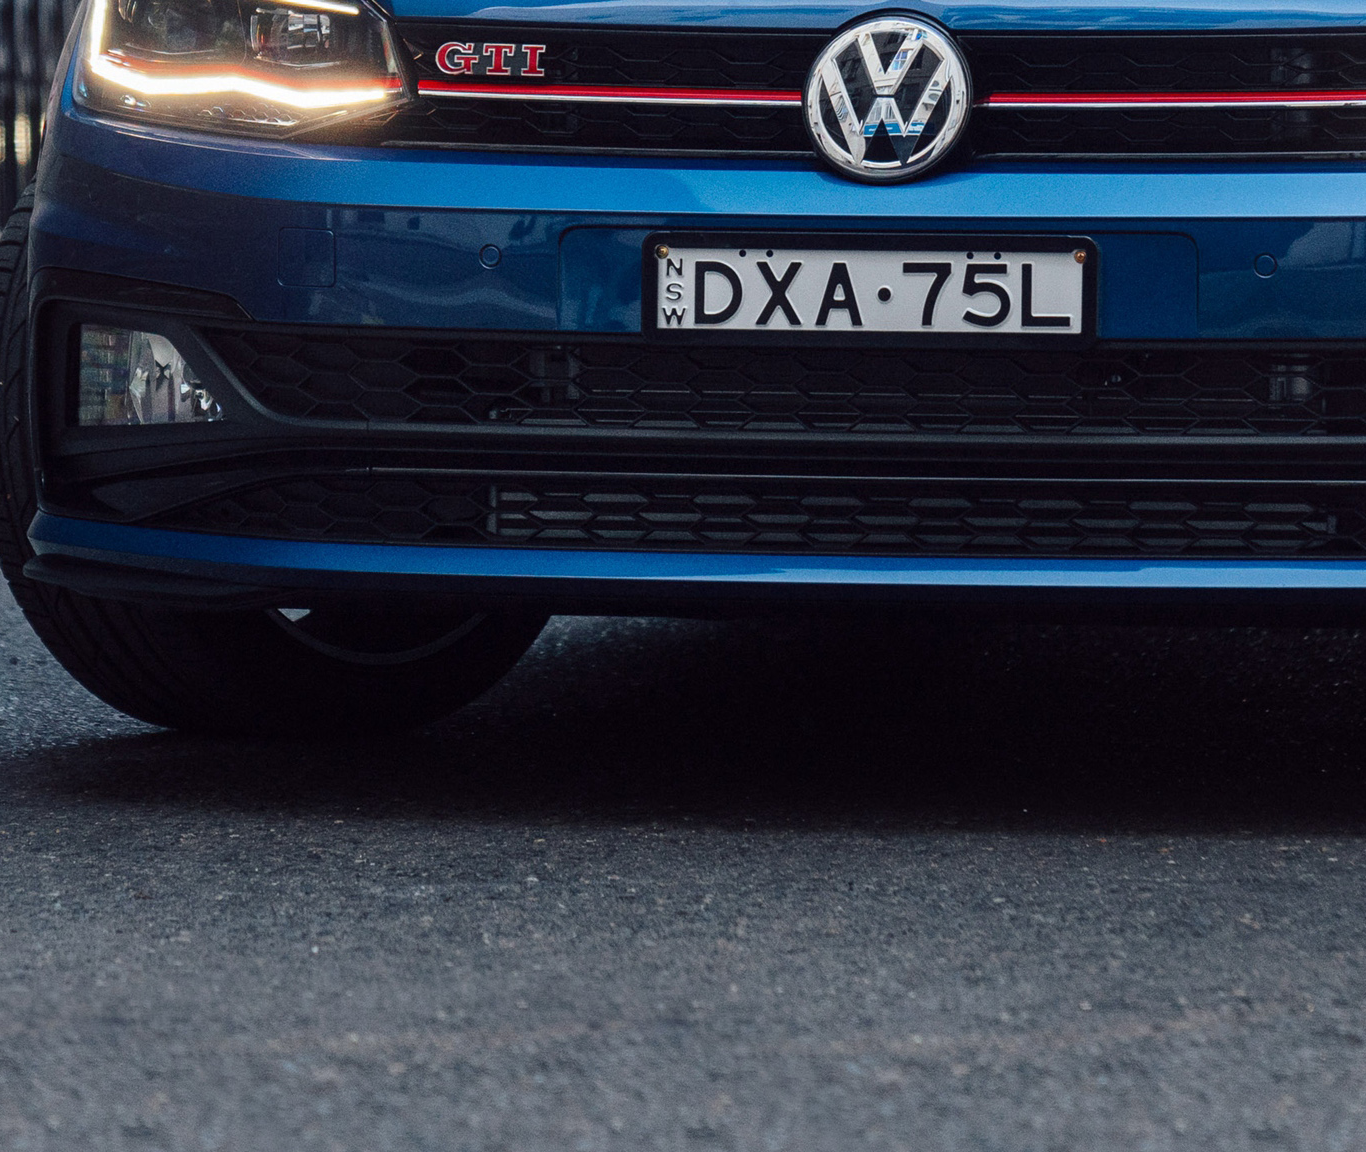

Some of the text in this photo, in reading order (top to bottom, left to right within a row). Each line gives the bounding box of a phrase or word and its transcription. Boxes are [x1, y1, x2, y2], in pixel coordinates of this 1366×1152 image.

[435, 41, 546, 77] GTI
[816, 27, 958, 168] VW
[661, 257, 686, 326] NSW
